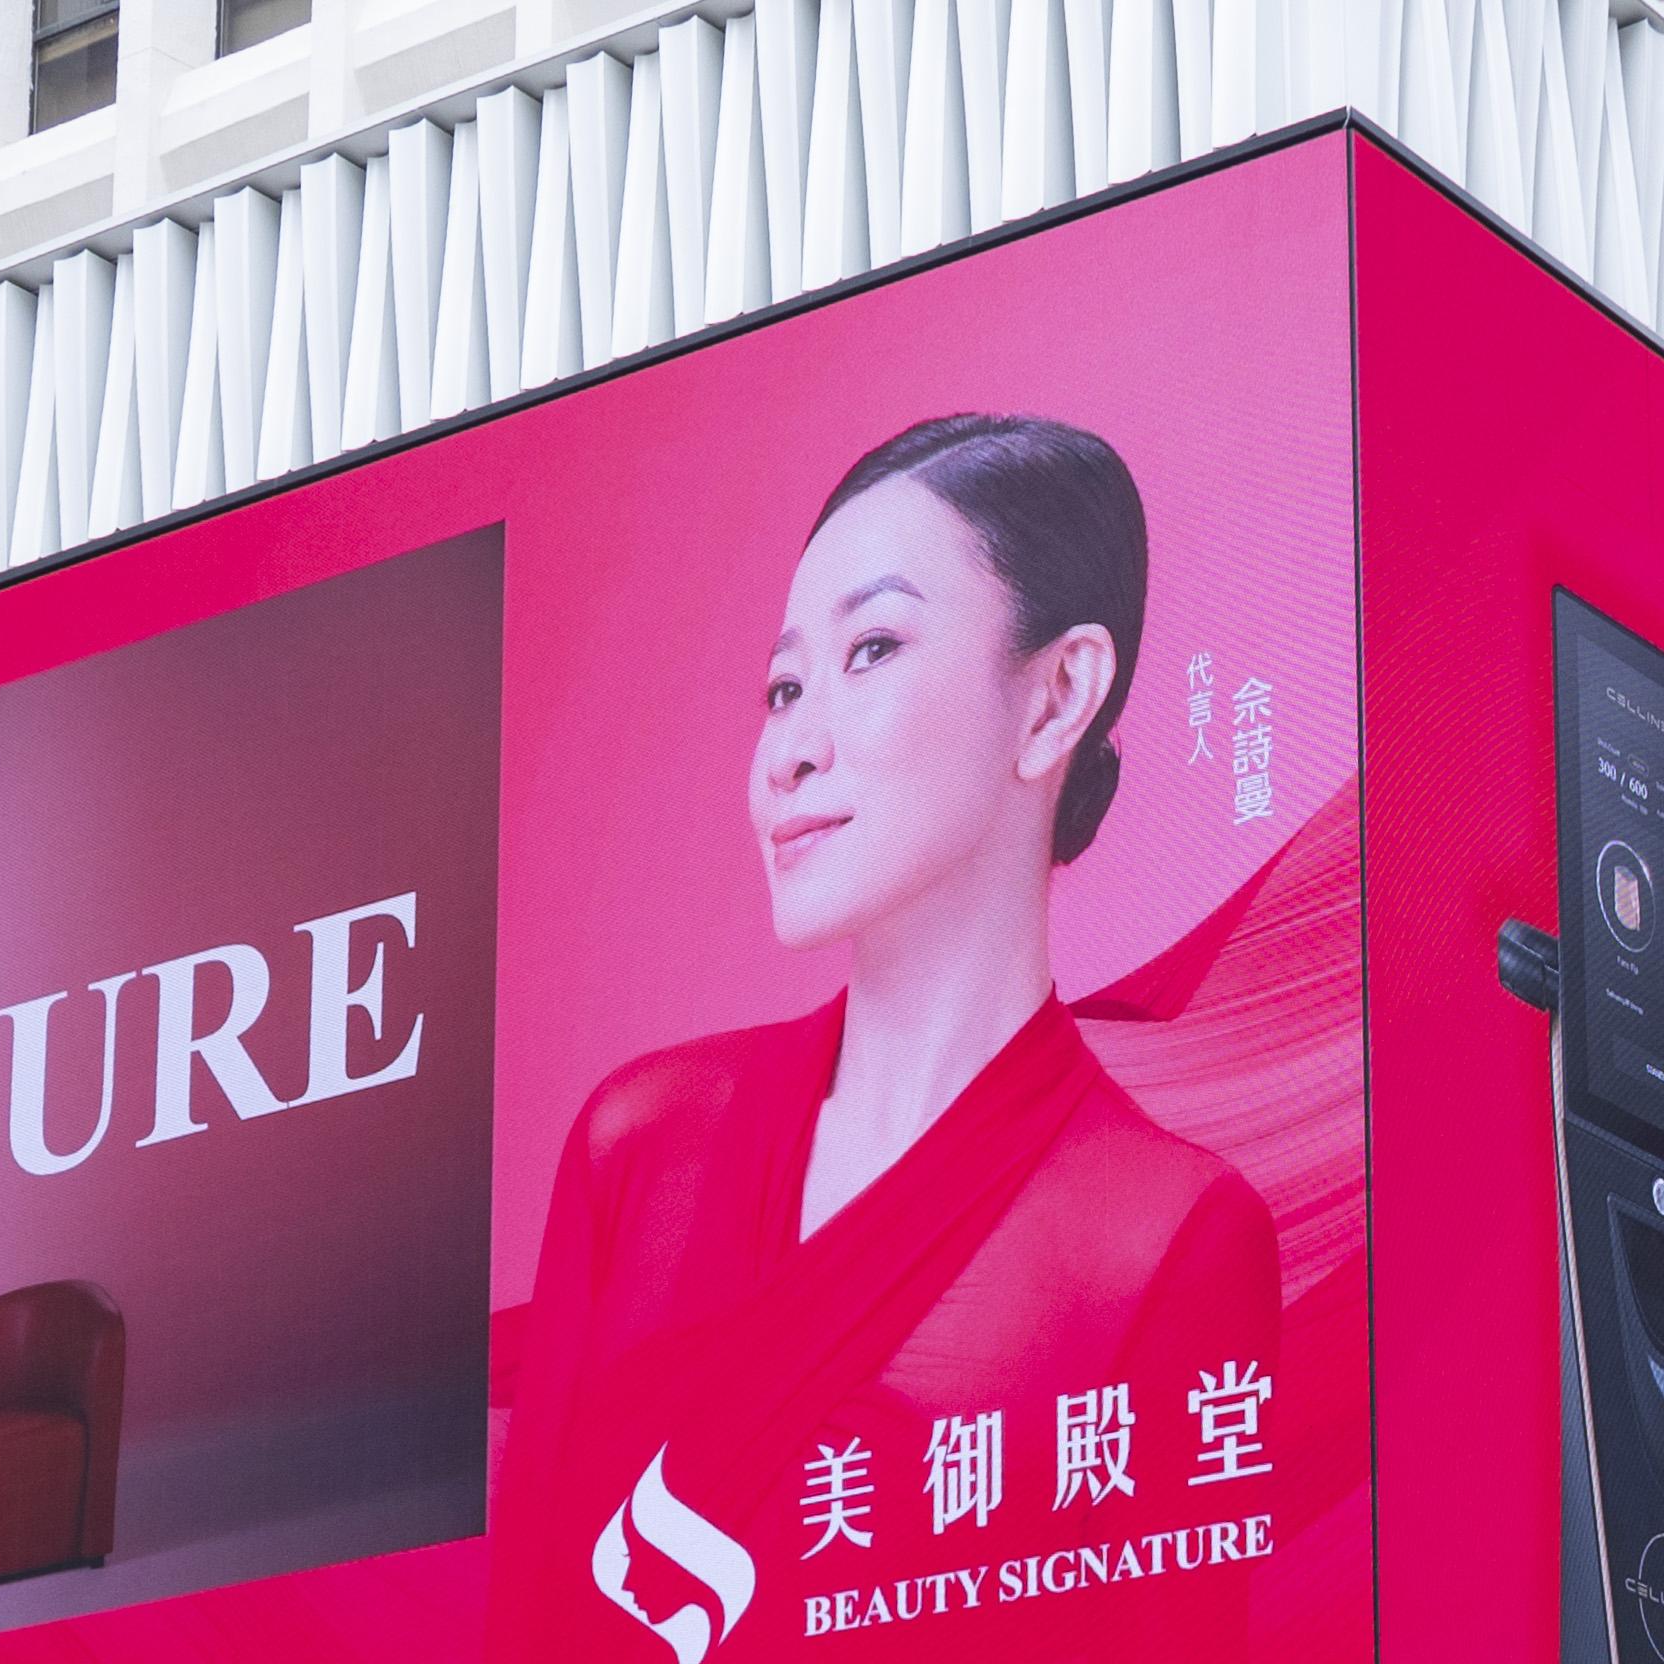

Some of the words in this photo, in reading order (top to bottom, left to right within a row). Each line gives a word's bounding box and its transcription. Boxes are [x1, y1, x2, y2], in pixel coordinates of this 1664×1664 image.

[1187, 652, 1213, 764] 代言人
[1598, 757, 1617, 781] 300
[1629, 777, 1648, 799] 600
[798, 1360, 1273, 1561] 美御殿堂
[804, 1565, 987, 1638] BEAUTY
[998, 1515, 1274, 1604] SIGNATURE
